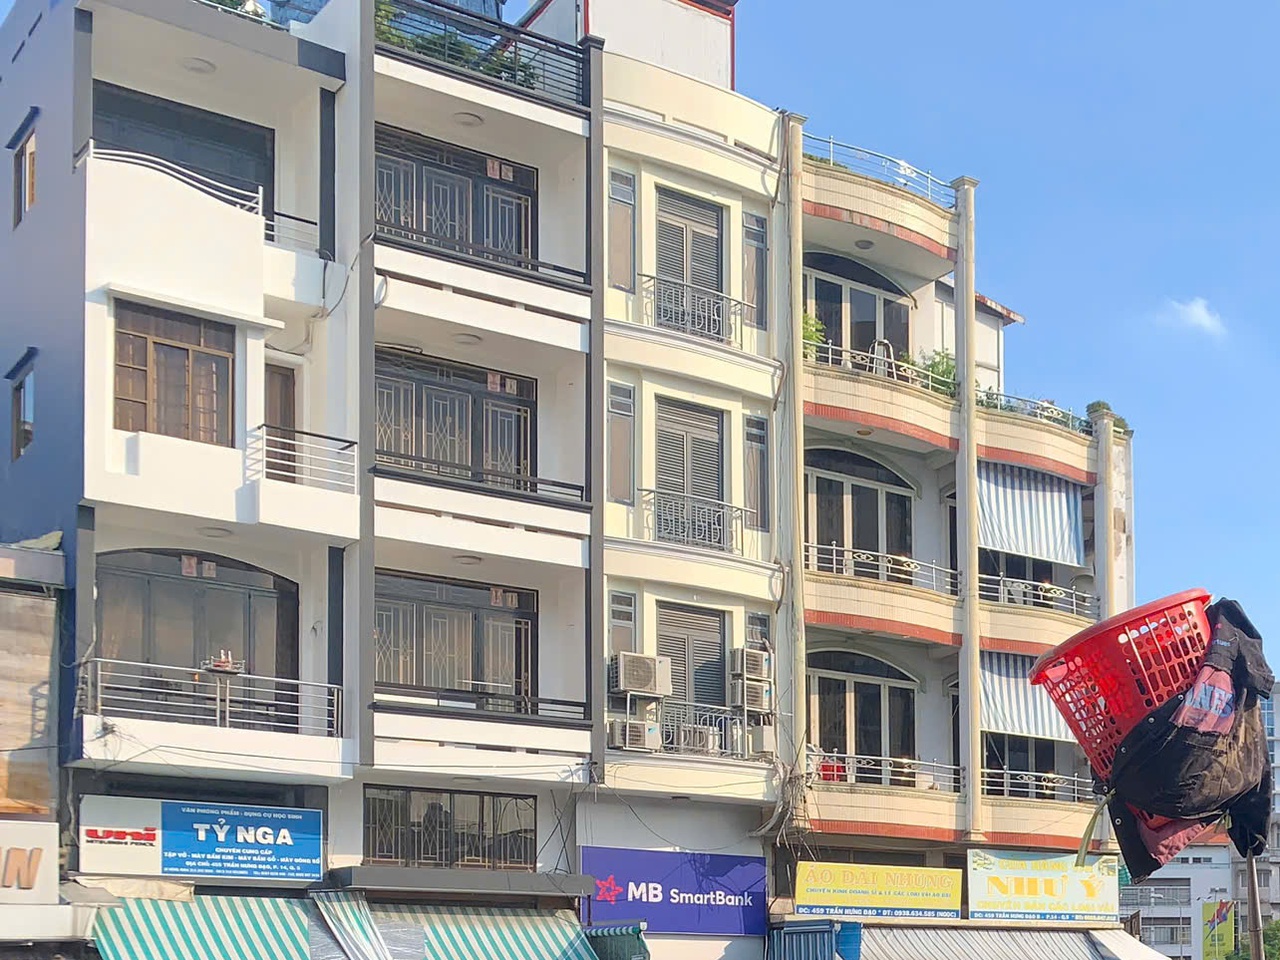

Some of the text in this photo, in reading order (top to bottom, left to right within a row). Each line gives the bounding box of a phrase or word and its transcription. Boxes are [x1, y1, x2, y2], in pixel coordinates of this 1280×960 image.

[86, 827, 156, 841] uni
[236, 825, 294, 845] NGA
[0, 847, 43, 890] N
[885, 872, 955, 889] NHUNG
[627, 881, 753, 907] MB SmartBank
